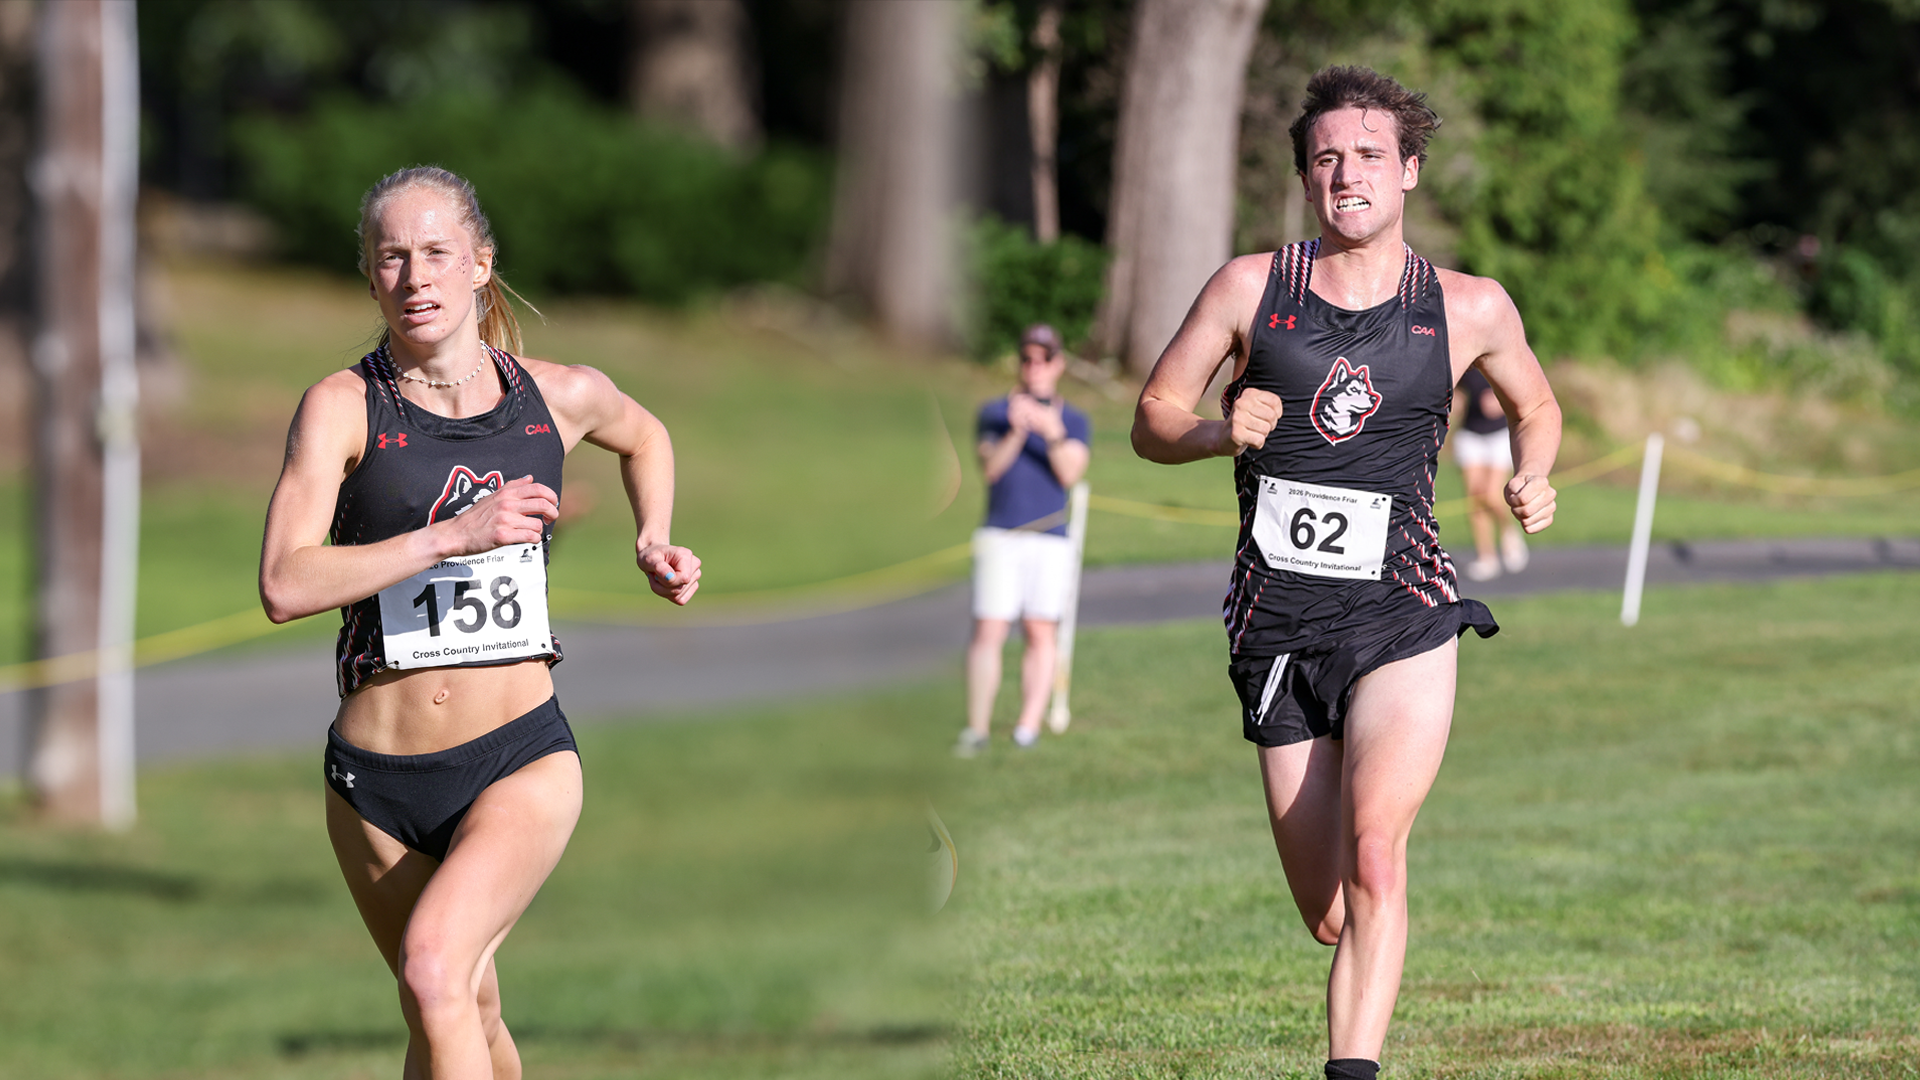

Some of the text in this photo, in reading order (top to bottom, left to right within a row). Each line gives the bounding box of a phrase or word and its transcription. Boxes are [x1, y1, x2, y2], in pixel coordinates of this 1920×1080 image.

[1411, 324, 1436, 337] CAA
[525, 423, 551, 435] CAA
[1305, 489, 1341, 502] Providence
[1342, 496, 1358, 504] Friar
[1290, 507, 1348, 555] 62
[441, 558, 485, 569] Providence
[487, 555, 504, 563] Friar
[1268, 553, 1361, 571] Cross Country Invitational
[413, 575, 521, 637] 158
[412, 639, 529, 660] Cross Country Invitational
